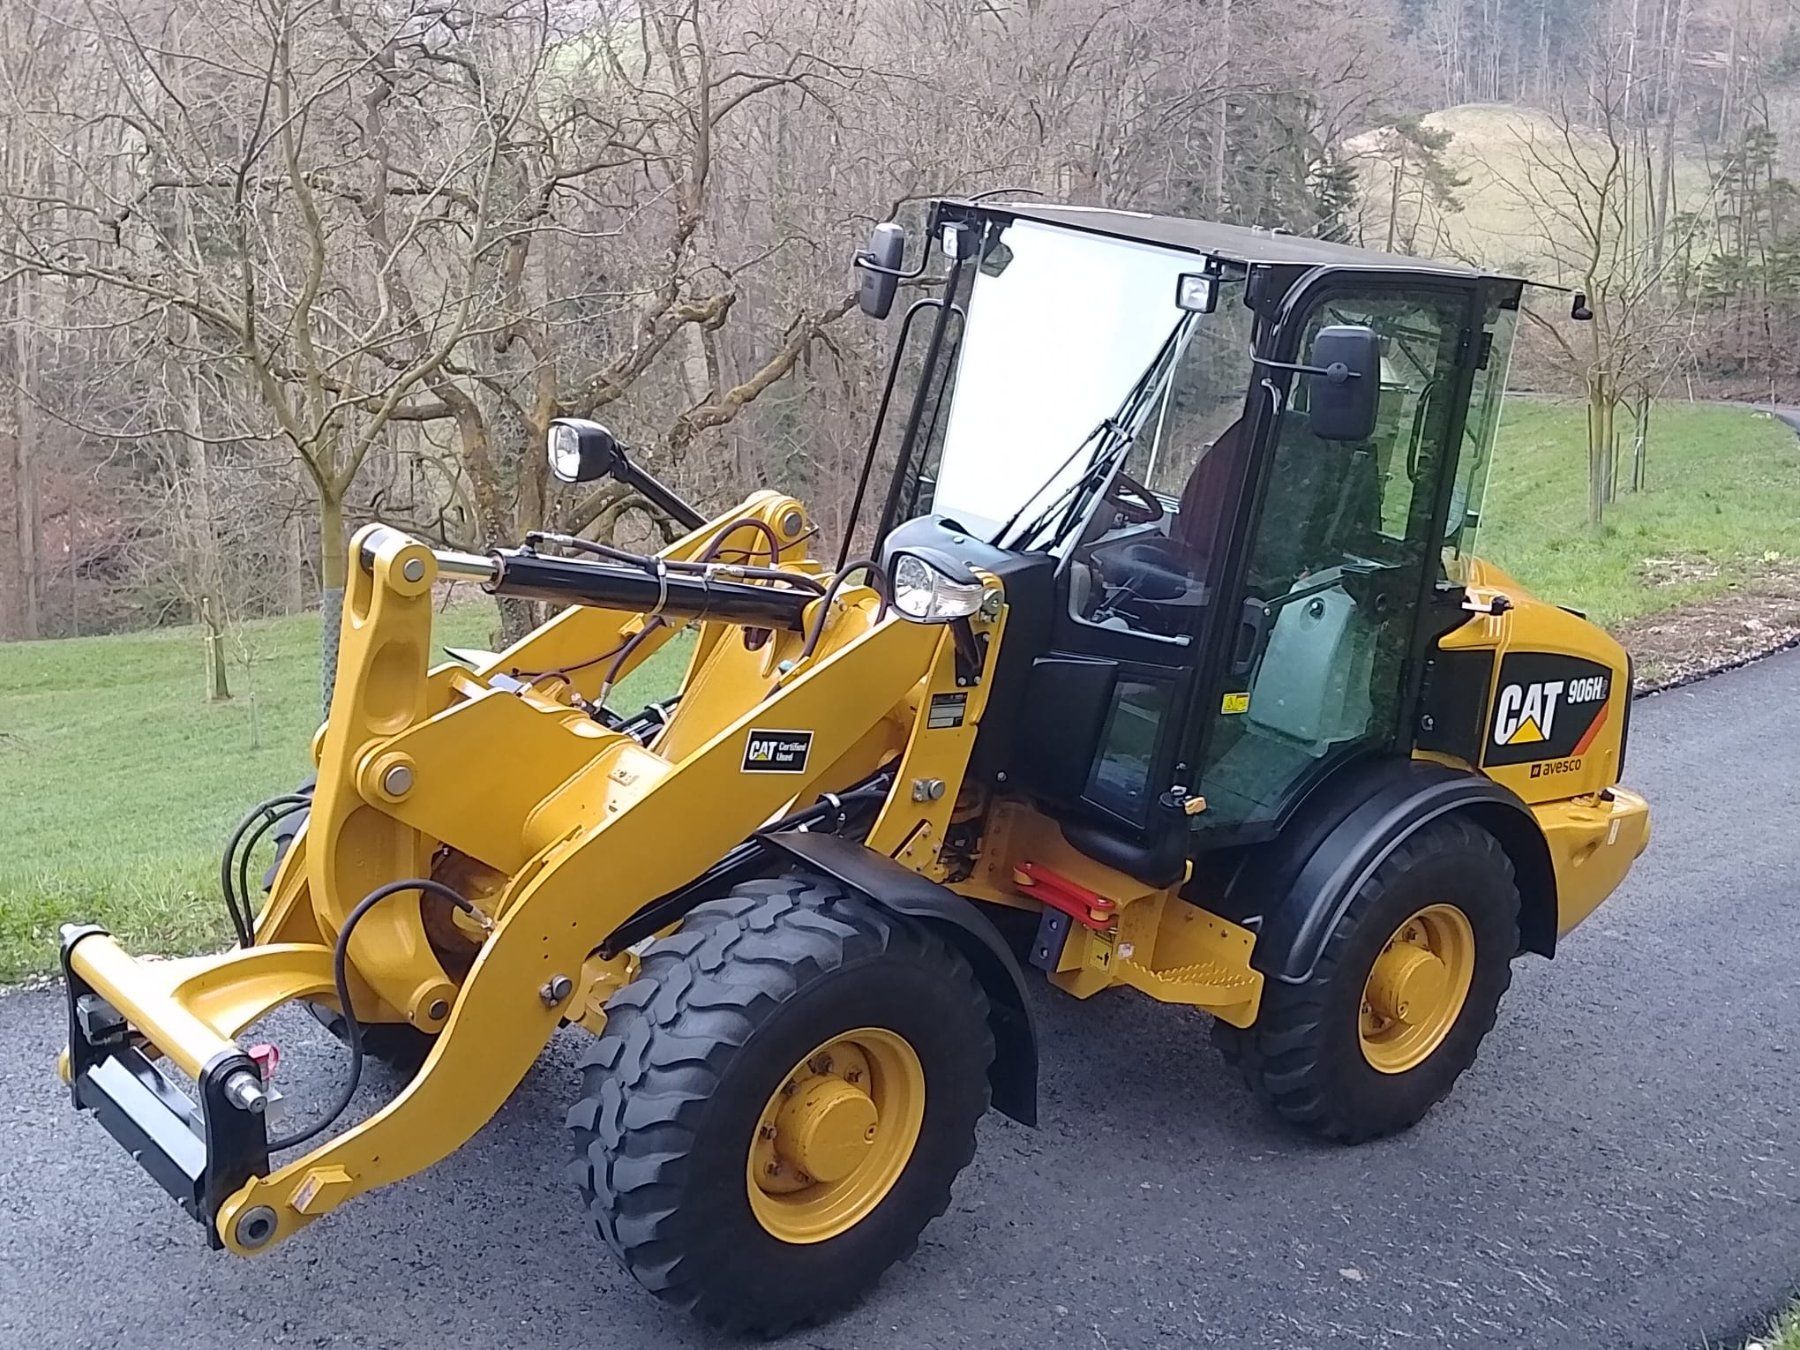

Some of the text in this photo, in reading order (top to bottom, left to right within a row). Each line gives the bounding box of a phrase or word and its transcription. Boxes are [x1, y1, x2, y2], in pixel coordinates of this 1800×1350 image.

[1494, 681, 1564, 745] CAT
[748, 740, 778, 761] CAT
[1542, 758, 1582, 776] avesco
